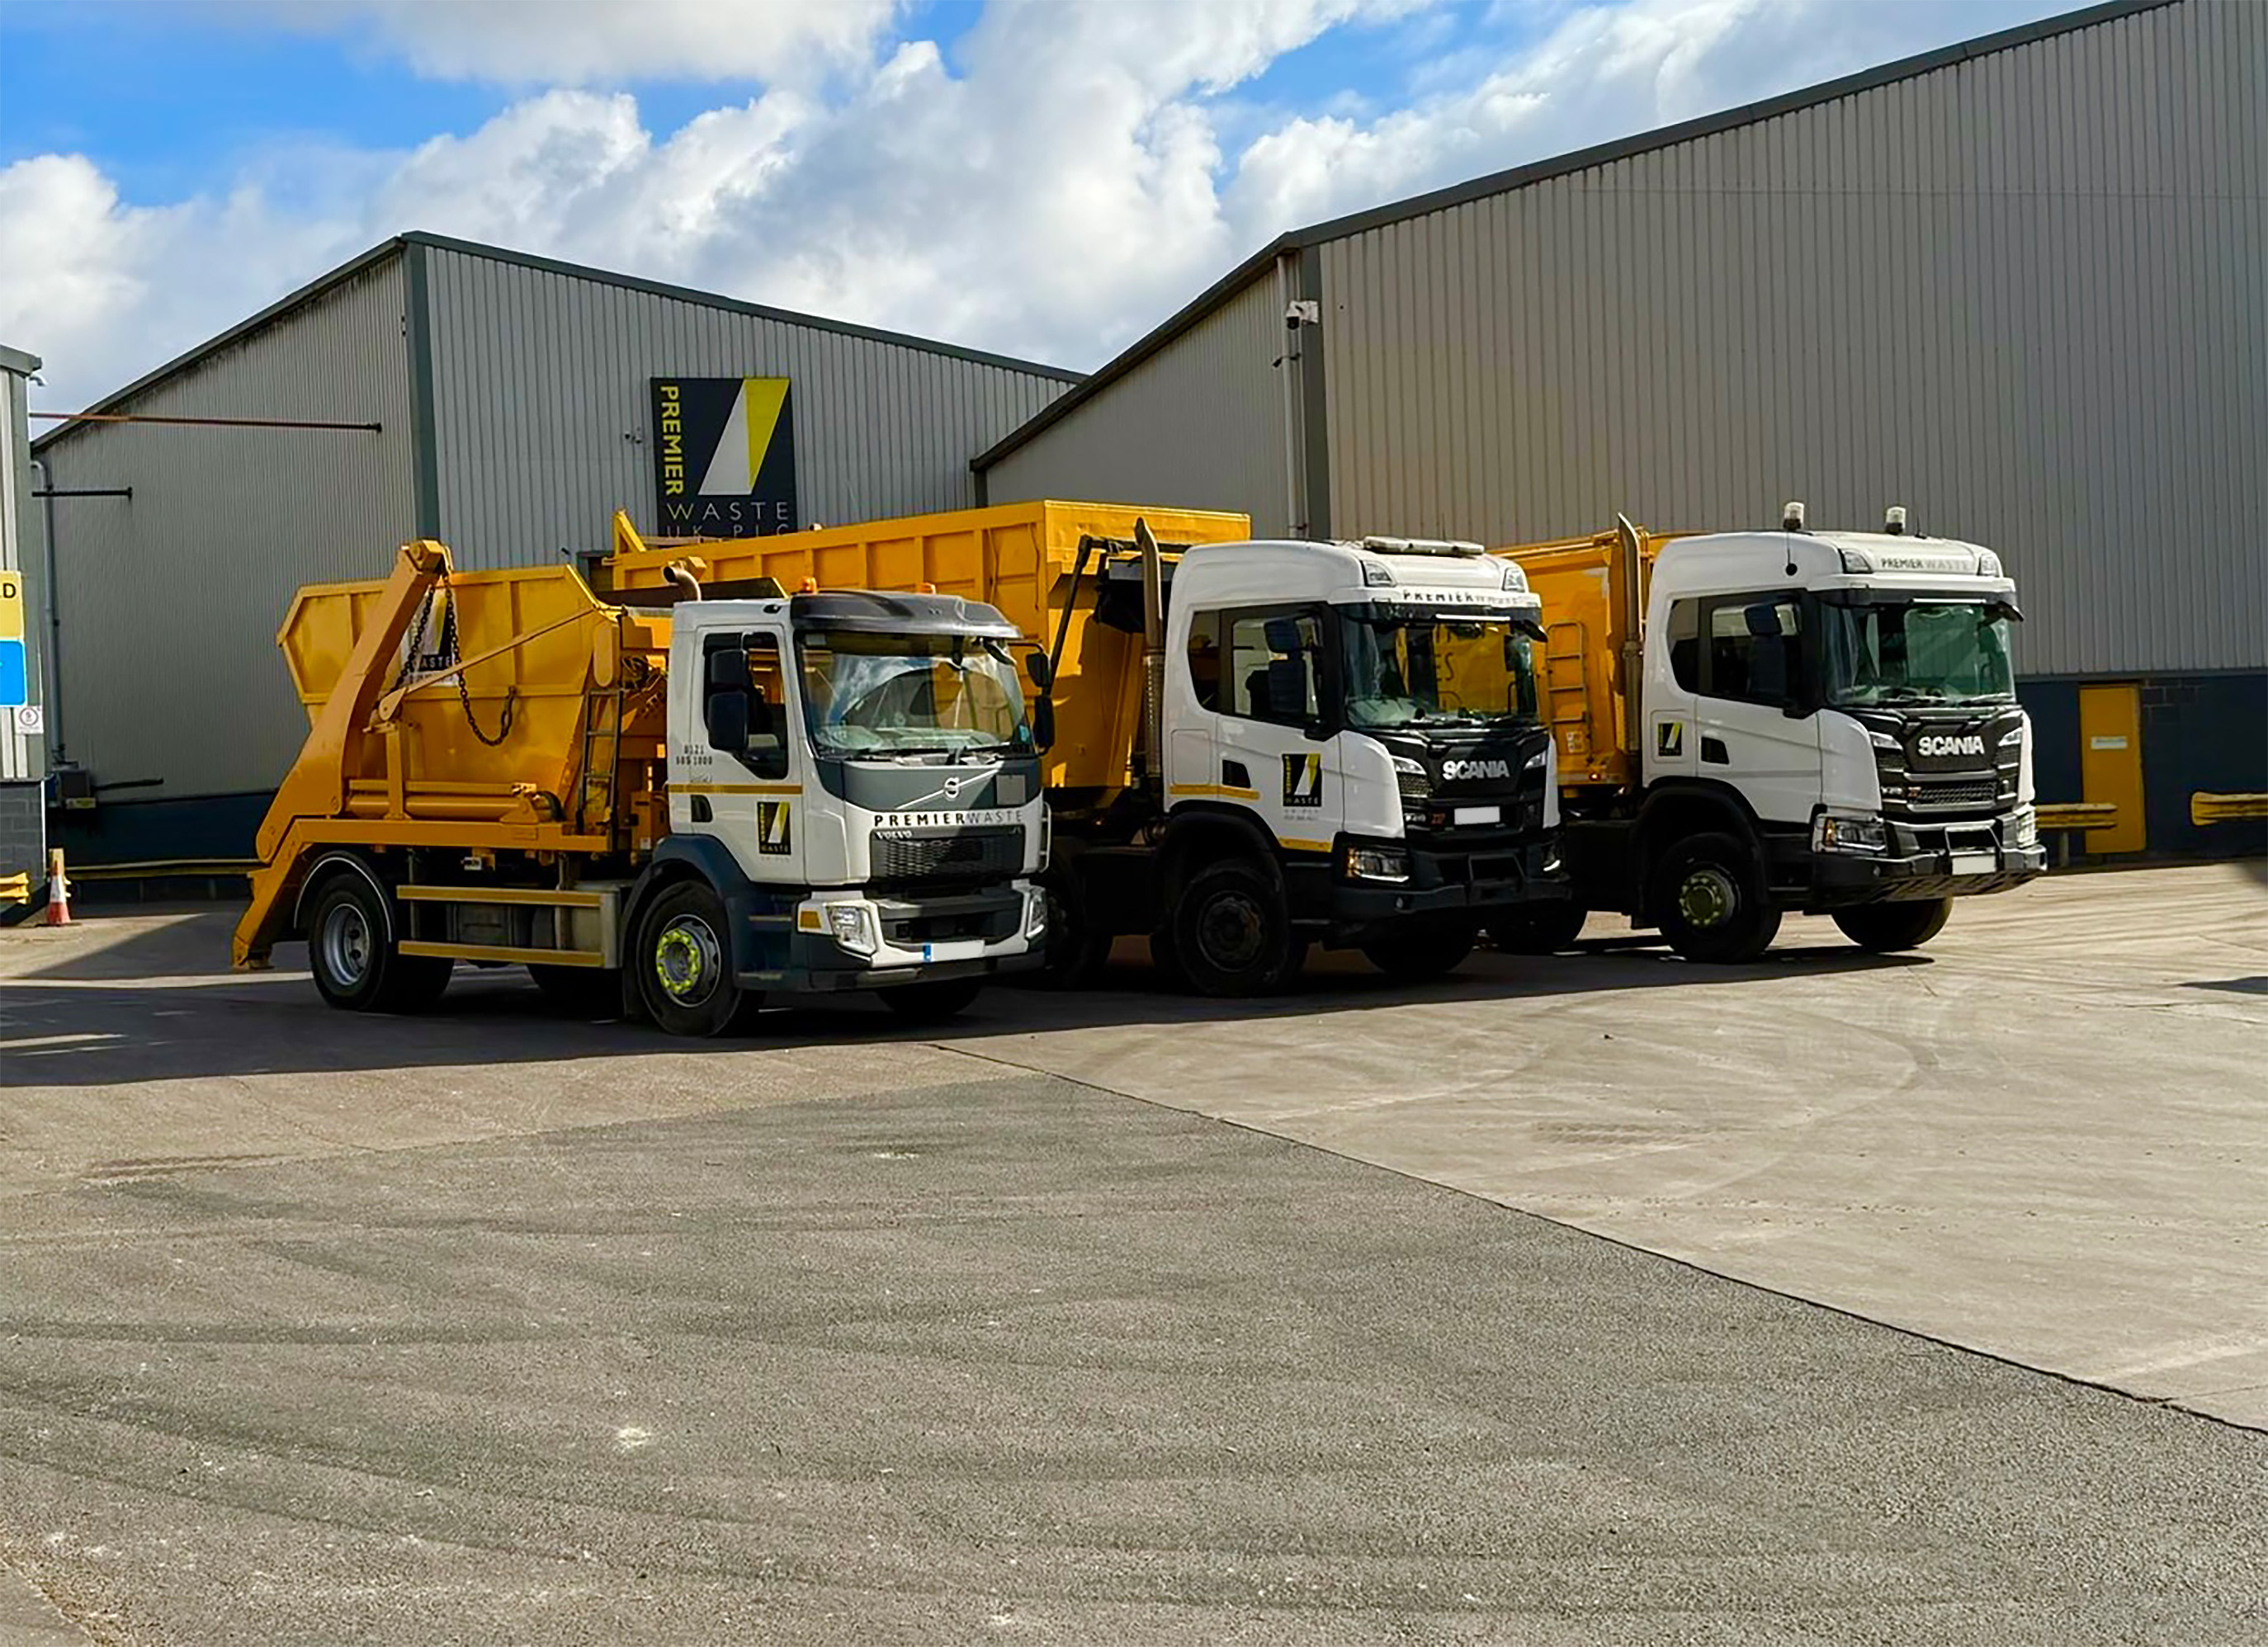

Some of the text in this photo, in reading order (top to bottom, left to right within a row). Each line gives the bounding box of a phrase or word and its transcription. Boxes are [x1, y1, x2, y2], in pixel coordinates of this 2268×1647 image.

[660, 385, 684, 496] PREMIER
[666, 502, 788, 521] WASTE
[0, 583, 17, 599] D
[411, 655, 453, 669] ASTE
[1917, 734, 1985, 756] SCANIA
[1442, 760, 1510, 780] SCANIA
[875, 830, 913, 841] VOLVO
